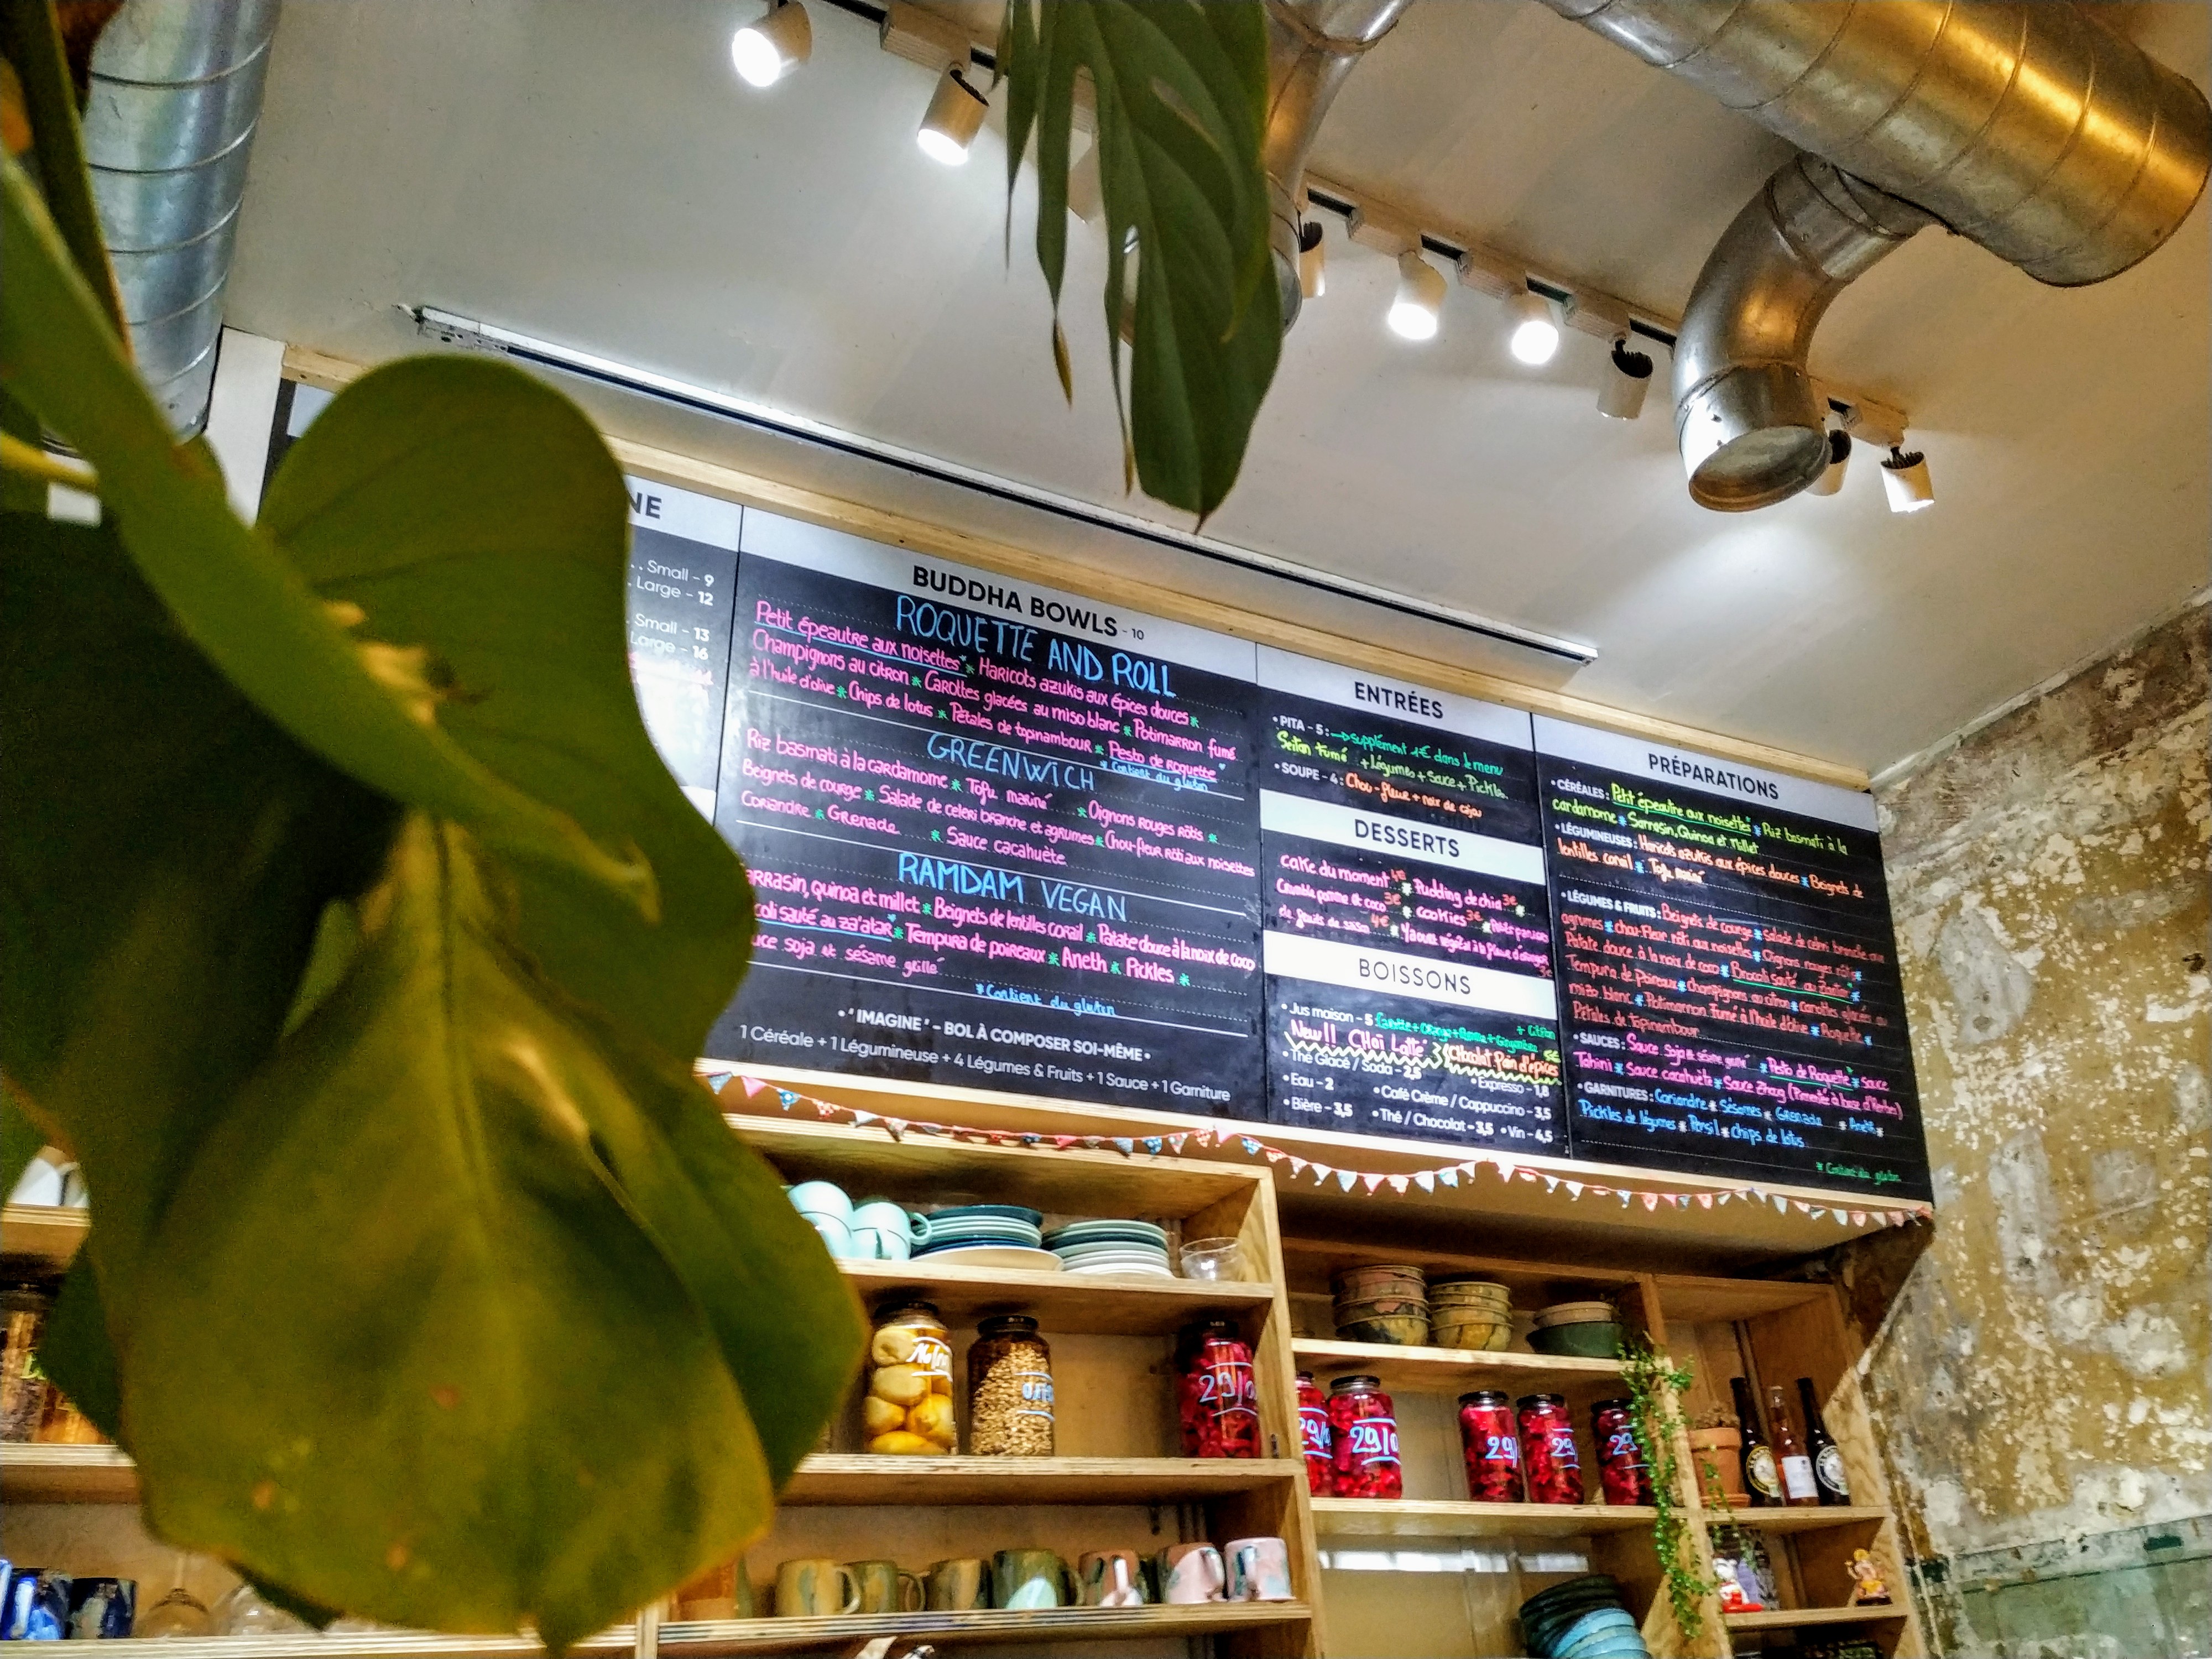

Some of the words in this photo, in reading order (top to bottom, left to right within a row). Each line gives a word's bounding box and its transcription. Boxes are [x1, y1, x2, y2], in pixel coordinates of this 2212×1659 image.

[637, 576, 681, 598] Large
[698, 591, 713, 606] 12
[647, 560, 688, 581] Small
[704, 575, 714, 587] 9
[913, 565, 1022, 613] BUDDHA
[1031, 596, 1118, 637] BOWLS
[1131, 628, 1145, 640] 10
[630, 631, 675, 653] Large
[692, 645, 708, 660] 16
[635, 613, 677, 634] Small
[694, 627, 709, 642] 13
[897, 595, 1038, 662] ROQUETTE
[1048, 639, 1104, 682] AND
[1112, 653, 1177, 698] ROLL
[756, 600, 792, 630] Petit
[797, 617, 869, 649] épeautre
[872, 638, 899, 657] aux
[901, 643, 960, 671] noisettes
[979, 657, 1036, 690] Haricots
[1040, 677, 1084, 698] azukis
[1086, 690, 1108, 707] aux
[1110, 693, 1147, 717] épices
[1151, 701, 1188, 726] douces
[753, 629, 845, 671] Champignons
[848, 657, 866, 675] au
[869, 660, 909, 685] citron
[924, 669, 980, 701] Carottes
[983, 691, 1027, 713] glacées
[1034, 701, 1049, 718] au
[1052, 706, 1085, 726] miso
[1087, 711, 1120, 734] blanc
[1133, 718, 1203, 753] Potimarron
[1208, 738, 1237, 761] fumé
[1354, 682, 1443, 719] ENTRÉES
[749, 656, 760, 676] à
[761, 659, 797, 685] l'huile
[799, 674, 836, 696] d'olive
[848, 680, 883, 709] Chips
[885, 691, 900, 711] de
[904, 697, 933, 718] lotus
[949, 701, 993, 731] Pétales
[997, 721, 1013, 735] de
[1015, 722, 1093, 754] topinambour
[1108, 740, 1145, 765] Pesto
[1150, 753, 1164, 768] de
[1166, 759, 1216, 780] roquette
[927, 733, 1094, 791] GREENWICH
[1276, 731, 1311, 757] Seitan
[1279, 715, 1305, 732] PITA
[1351, 734, 1407, 755] supplément
[1434, 749, 1459, 767] dans
[1473, 761, 1503, 775] menu
[747, 728, 771, 752] Riz
[776, 734, 837, 765] basmati
[840, 748, 851, 769] à
[853, 750, 865, 772] la
[868, 759, 948, 790] cardamome
[965, 777, 998, 805] Tofu
[1006, 790, 1052, 810] mariné
[1088, 800, 1135, 828] Oignons
[1138, 816, 1175, 838] rouges
[1282, 762, 1319, 781] SOUPE
[1648, 753, 1779, 799] PRÉPARATIONS
[741, 791, 811, 818] Coriandre
[827, 805, 900, 835] Grenade
[946, 826, 988, 851] Sauce
[994, 838, 1067, 867] cacahuète
[1354, 819, 1460, 857] DESSERTS
[899, 852, 1024, 904] RAMDAM
[1041, 880, 1126, 922] VEGAN
[1319, 860, 1336, 879] du
[1338, 869, 1390, 889] moment
[1412, 878, 1462, 908] Pudding
[1464, 889, 1476, 905] de
[1477, 892, 1502, 910] chia
[1567, 889, 1614, 911] LÉGUMES
[1359, 958, 1471, 995] BOISSONS
[1289, 1002, 1310, 1017] Jus
[1312, 1007, 1354, 1024] maison
[1365, 1013, 1374, 1026] 5
[943, 1021, 974, 1039] BOL
[975, 1023, 988, 1041] À
[990, 1028, 1070, 1052] COMPOSER
[1073, 1040, 1142, 1062] SOI-MÊME
[740, 1025, 747, 1039] 1
[750, 1026, 813, 1048] Céréale
[830, 1037, 837, 1050] 1
[841, 1037, 939, 1064] Légumineuse
[953, 1053, 964, 1066] 4
[967, 1055, 1030, 1076] Légumes
[1033, 1064, 1044, 1078] &
[1047, 1065, 1083, 1083] Fruits
[1097, 1071, 1104, 1084] 1
[1107, 1076, 1147, 1091] Sauce
[1162, 1079, 1168, 1093] 1
[1170, 1081, 1231, 1102] Garniture
[1291, 1050, 1312, 1062] Thé
[1314, 1052, 1351, 1071] Glacé
[1361, 1060, 1394, 1076] Soda
[1573, 1051, 1613, 1072] Tahini
[1625, 1062, 1658, 1078] Sauce
[1290, 1072, 1314, 1088] Eau
[1325, 1077, 1334, 1091] 2
[1478, 1076, 1525, 1095] Expresso
[1381, 1086, 1410, 1102] Café
[1412, 1091, 1448, 1107] Crème
[1458, 1095, 1525, 1118] Cappuccino
[1291, 1097, 1323, 1114] Bière
[1380, 1108, 1402, 1124] Thé
[1412, 1112, 1467, 1132] Chocolat
[1508, 1125, 1525, 1139] Vin
